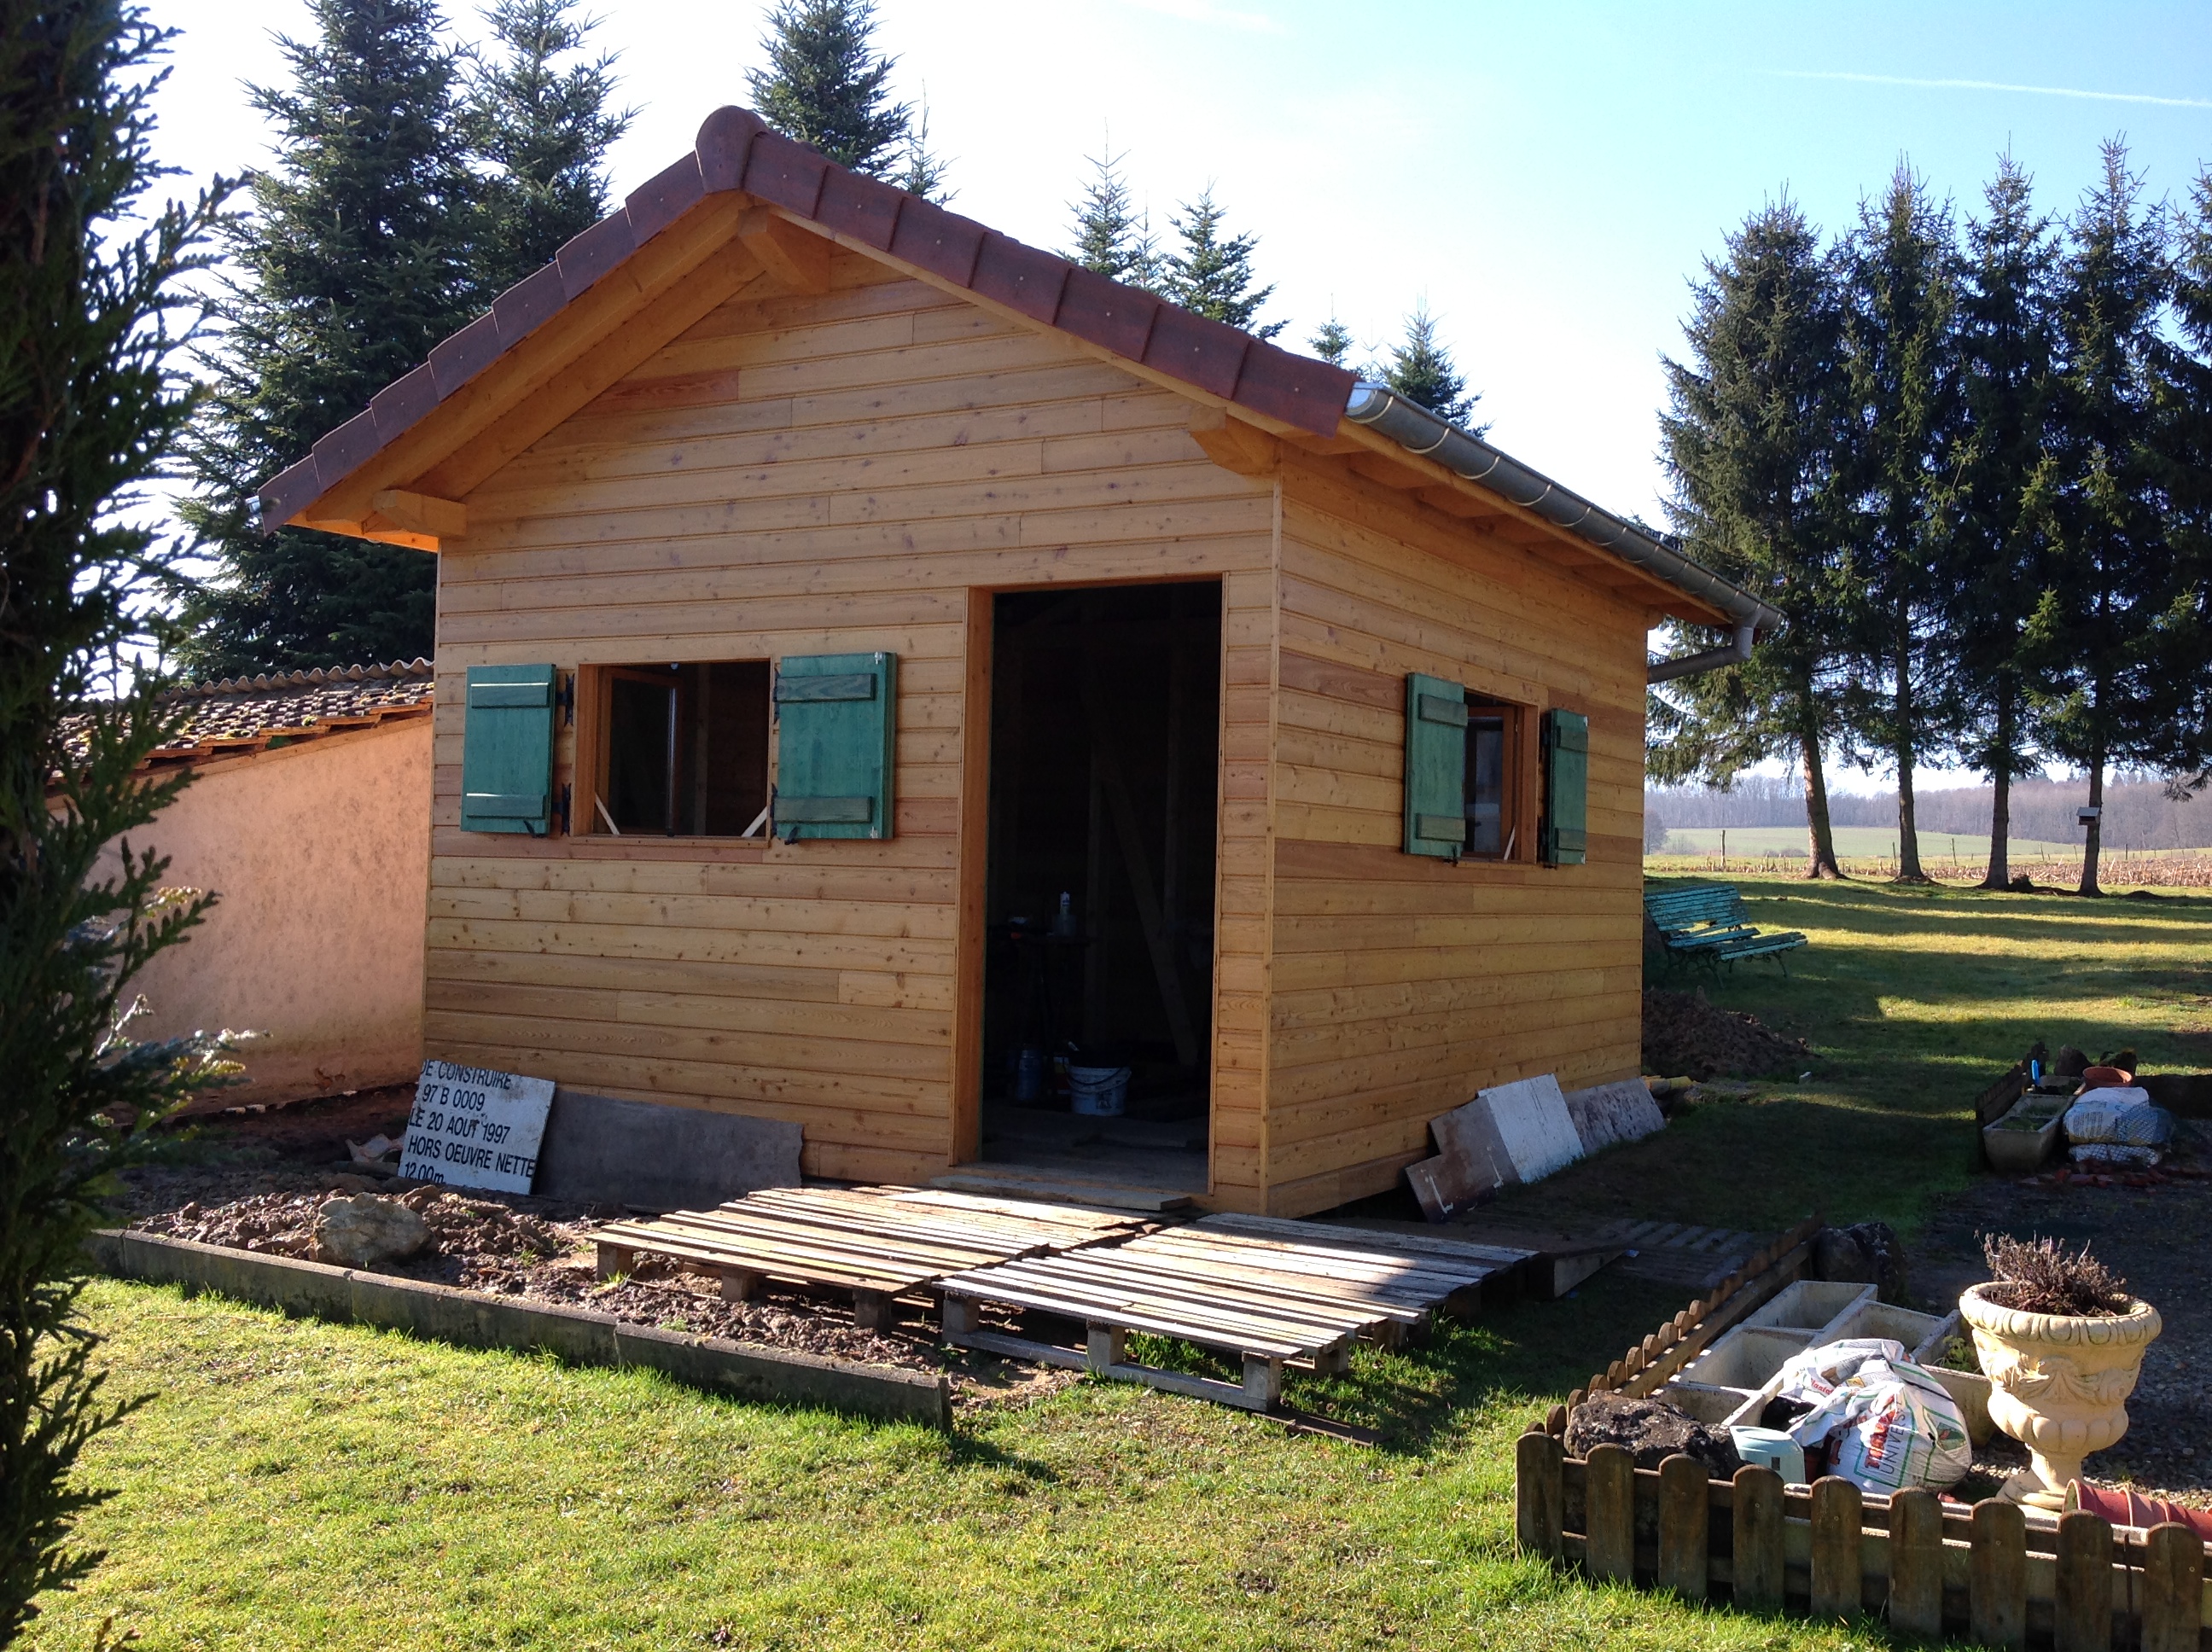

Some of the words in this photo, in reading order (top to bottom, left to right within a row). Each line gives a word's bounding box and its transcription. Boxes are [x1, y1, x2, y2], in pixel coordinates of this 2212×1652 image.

[438, 1062, 511, 1090] CONSTRUIRE
[422, 1084, 438, 1102] 97
[439, 1087, 450, 1105] B
[453, 1089, 485, 1111] 0009
[409, 1108, 426, 1127] LE
[427, 1111, 444, 1131] 20
[445, 1115, 480, 1138] AOUT
[482, 1122, 510, 1144] 1997
[408, 1135, 442, 1159] HORS
[445, 1142, 493, 1169] OEUVRE
[495, 1152, 537, 1178] NETTE
[1881, 1397, 1906, 1475] UNIVERSL
